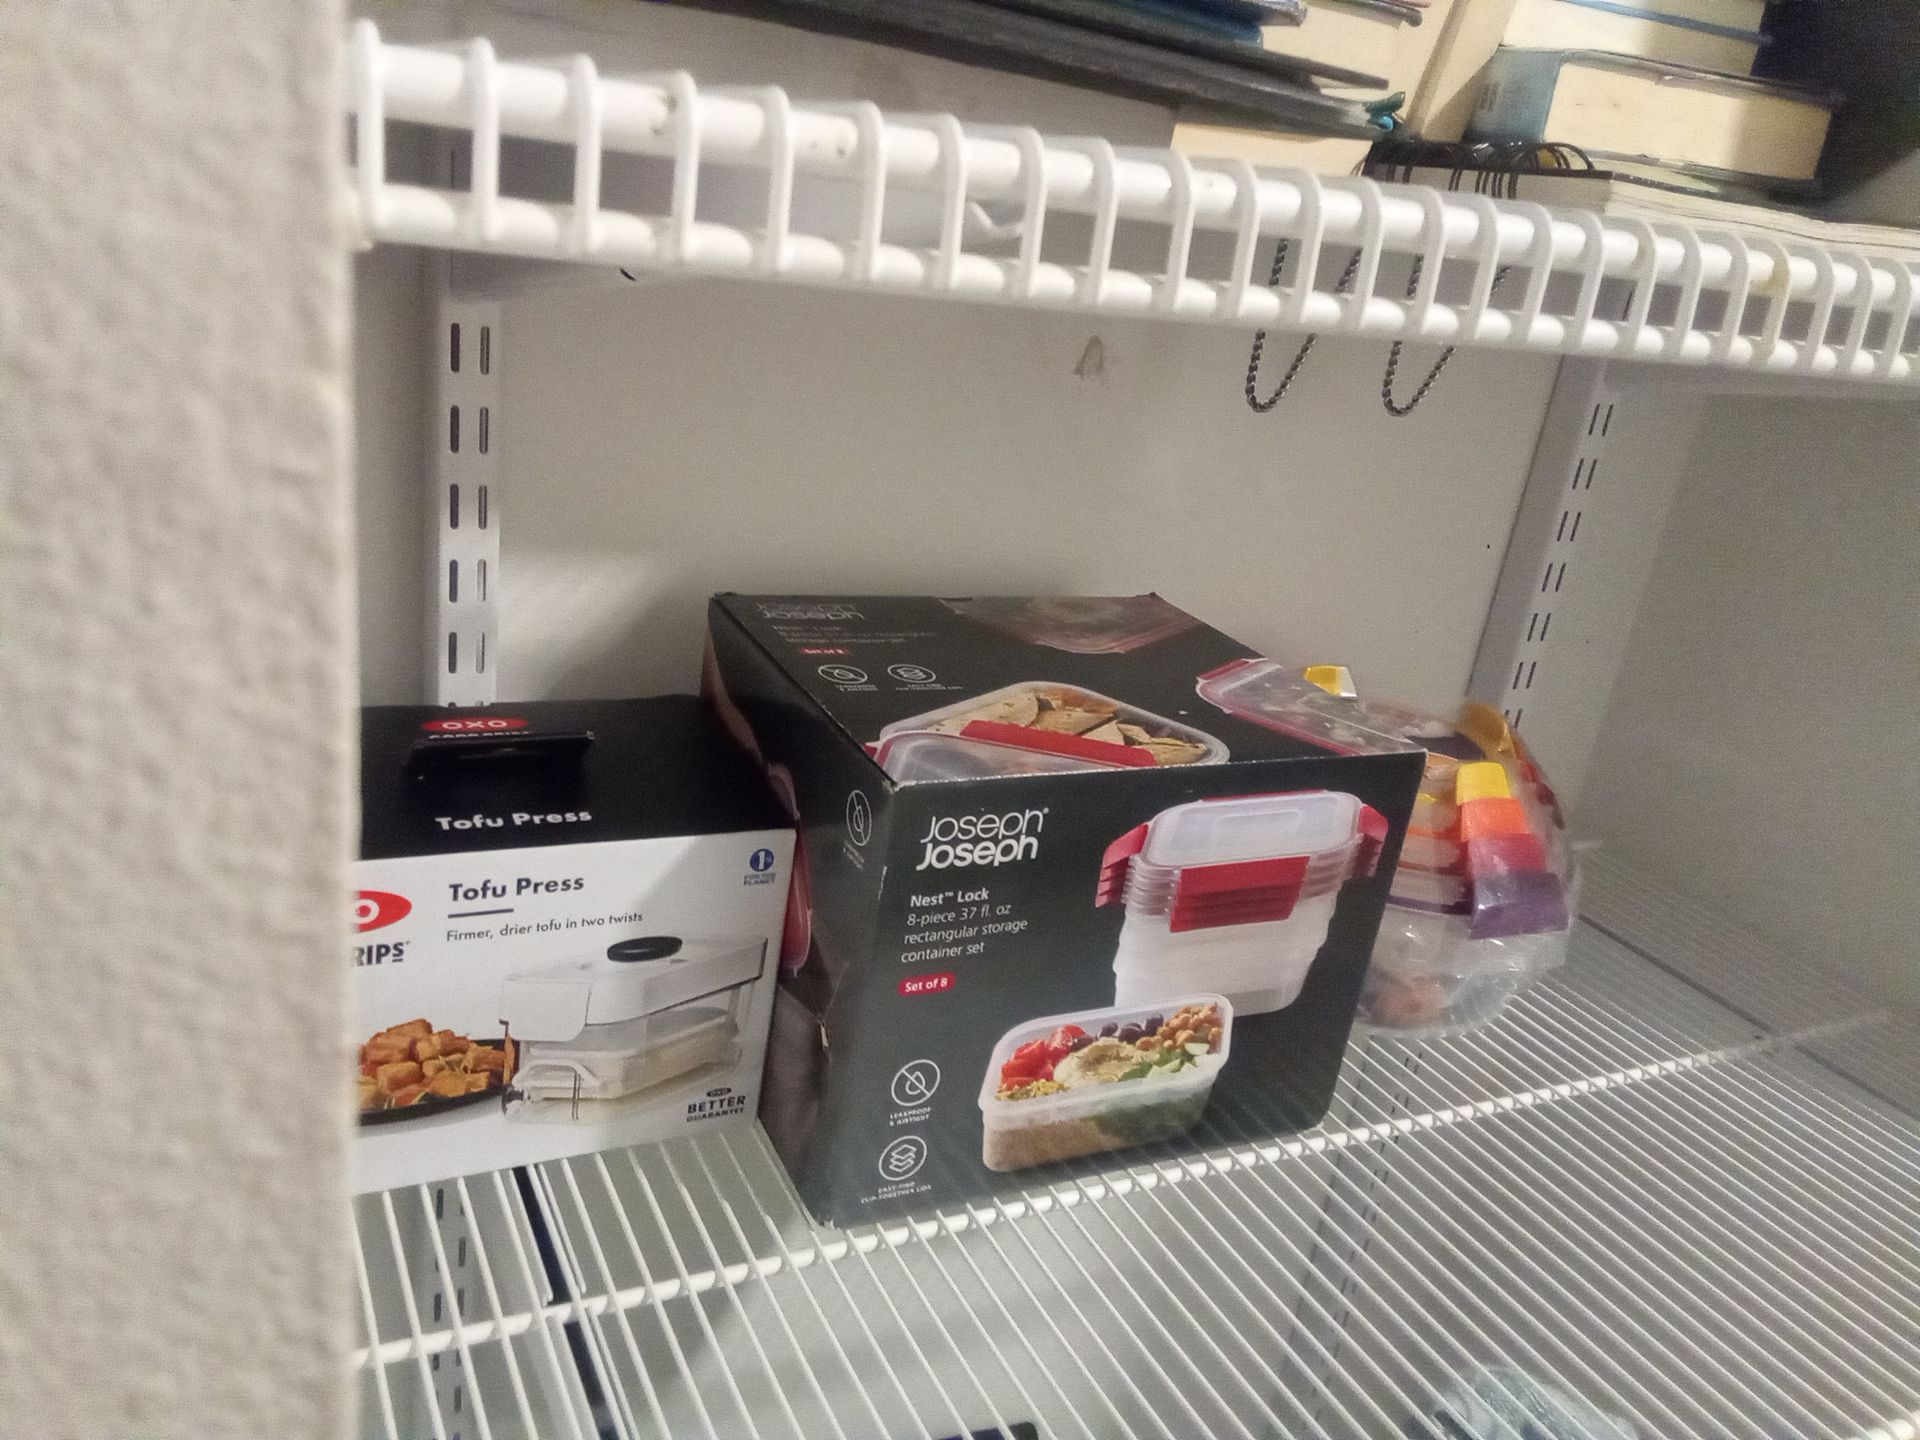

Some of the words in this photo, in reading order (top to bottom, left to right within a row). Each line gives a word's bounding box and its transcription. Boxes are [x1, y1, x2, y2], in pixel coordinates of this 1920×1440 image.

[442, 719, 508, 730] OXO
[435, 814, 504, 831] Tofu
[511, 811, 592, 826] Press
[920, 809, 1044, 843] Joseph
[915, 834, 1038, 871] Joseph
[448, 879, 507, 902] Tofu
[516, 877, 584, 896] Press
[957, 887, 989, 903] Lock
[446, 928, 495, 942] Firmer,
[500, 923, 532, 936] drier
[536, 918, 561, 932] tofu
[566, 918, 577, 929] in
[581, 917, 605, 927] two
[608, 911, 643, 924] twists
[906, 911, 956, 927] 8-piece
[960, 907, 977, 920] 37
[996, 903, 1011, 915] oz
[903, 926, 979, 945] rectangular
[981, 918, 1028, 934] storage
[352, 941, 404, 967] RIPS
[900, 944, 963, 963] container
[966, 941, 985, 955] set
[904, 980, 923, 992] Set
[925, 978, 938, 990] of
[940, 977, 948, 988] 8
[688, 1095, 746, 1114] BETTER
